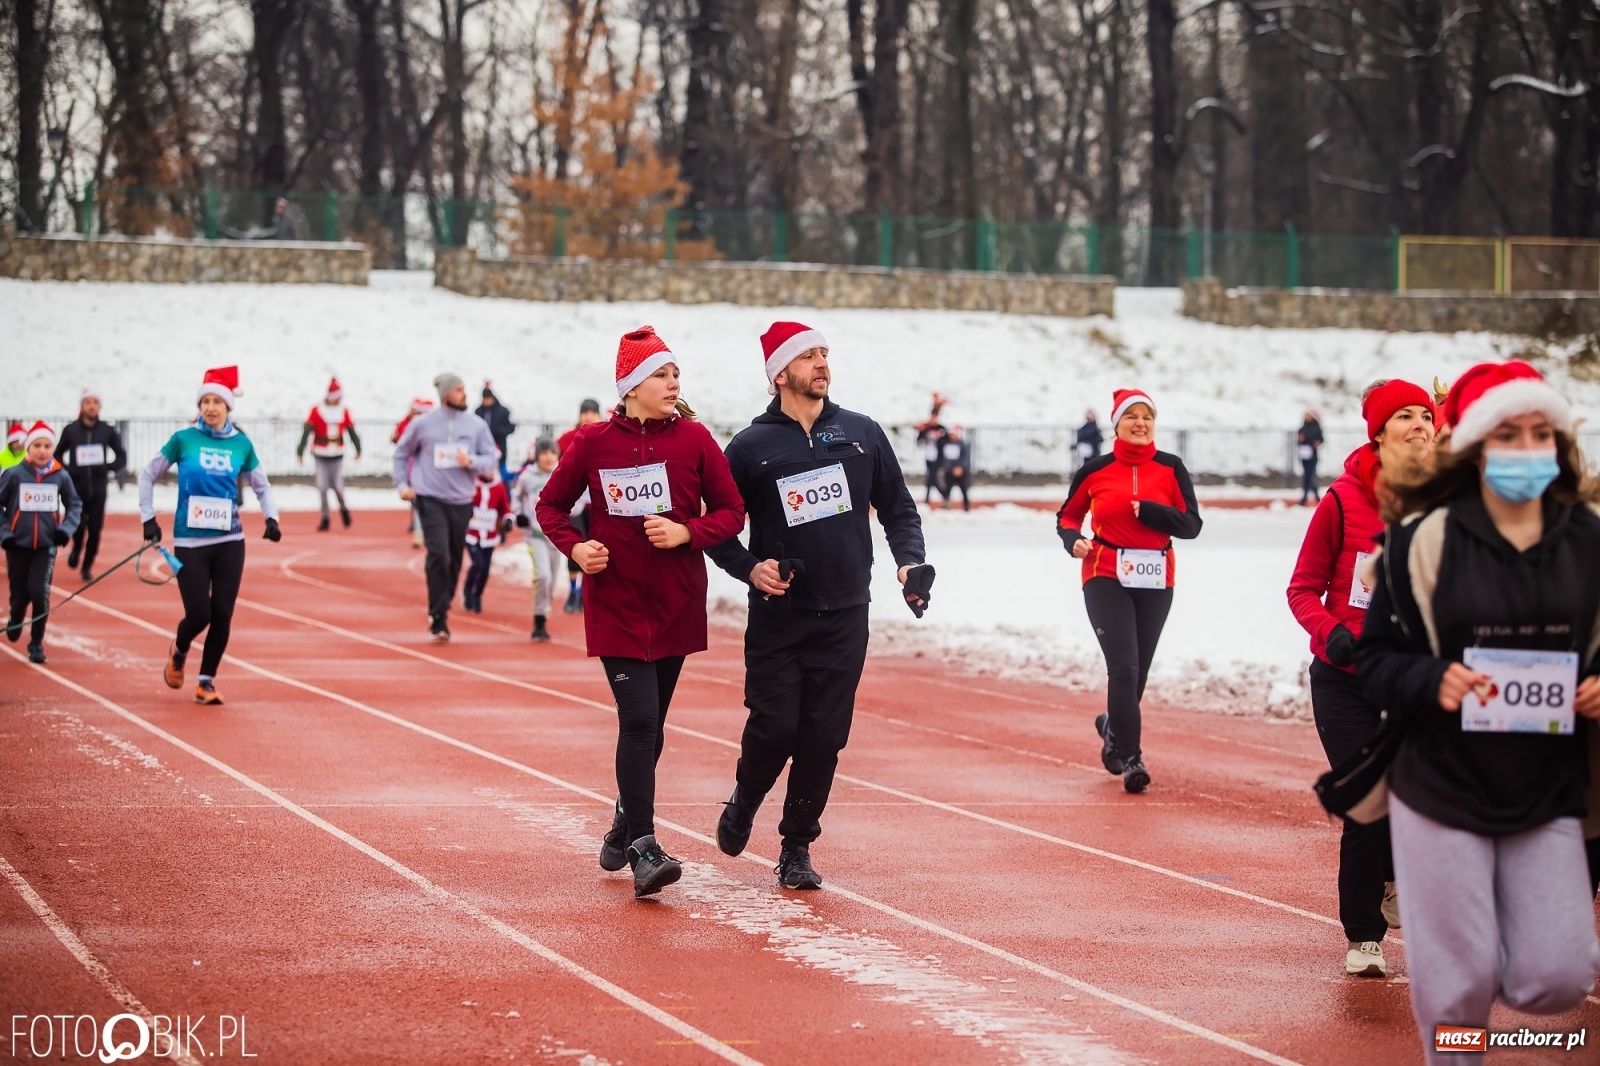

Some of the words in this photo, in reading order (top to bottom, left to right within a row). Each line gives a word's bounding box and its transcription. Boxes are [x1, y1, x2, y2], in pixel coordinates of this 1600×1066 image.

[33, 493, 54, 504] 036
[625, 481, 663, 502] 040
[806, 482, 843, 505] 039
[204, 508, 227, 520] 084
[1136, 563, 1162, 576] 006
[1504, 681, 1564, 708] 088
